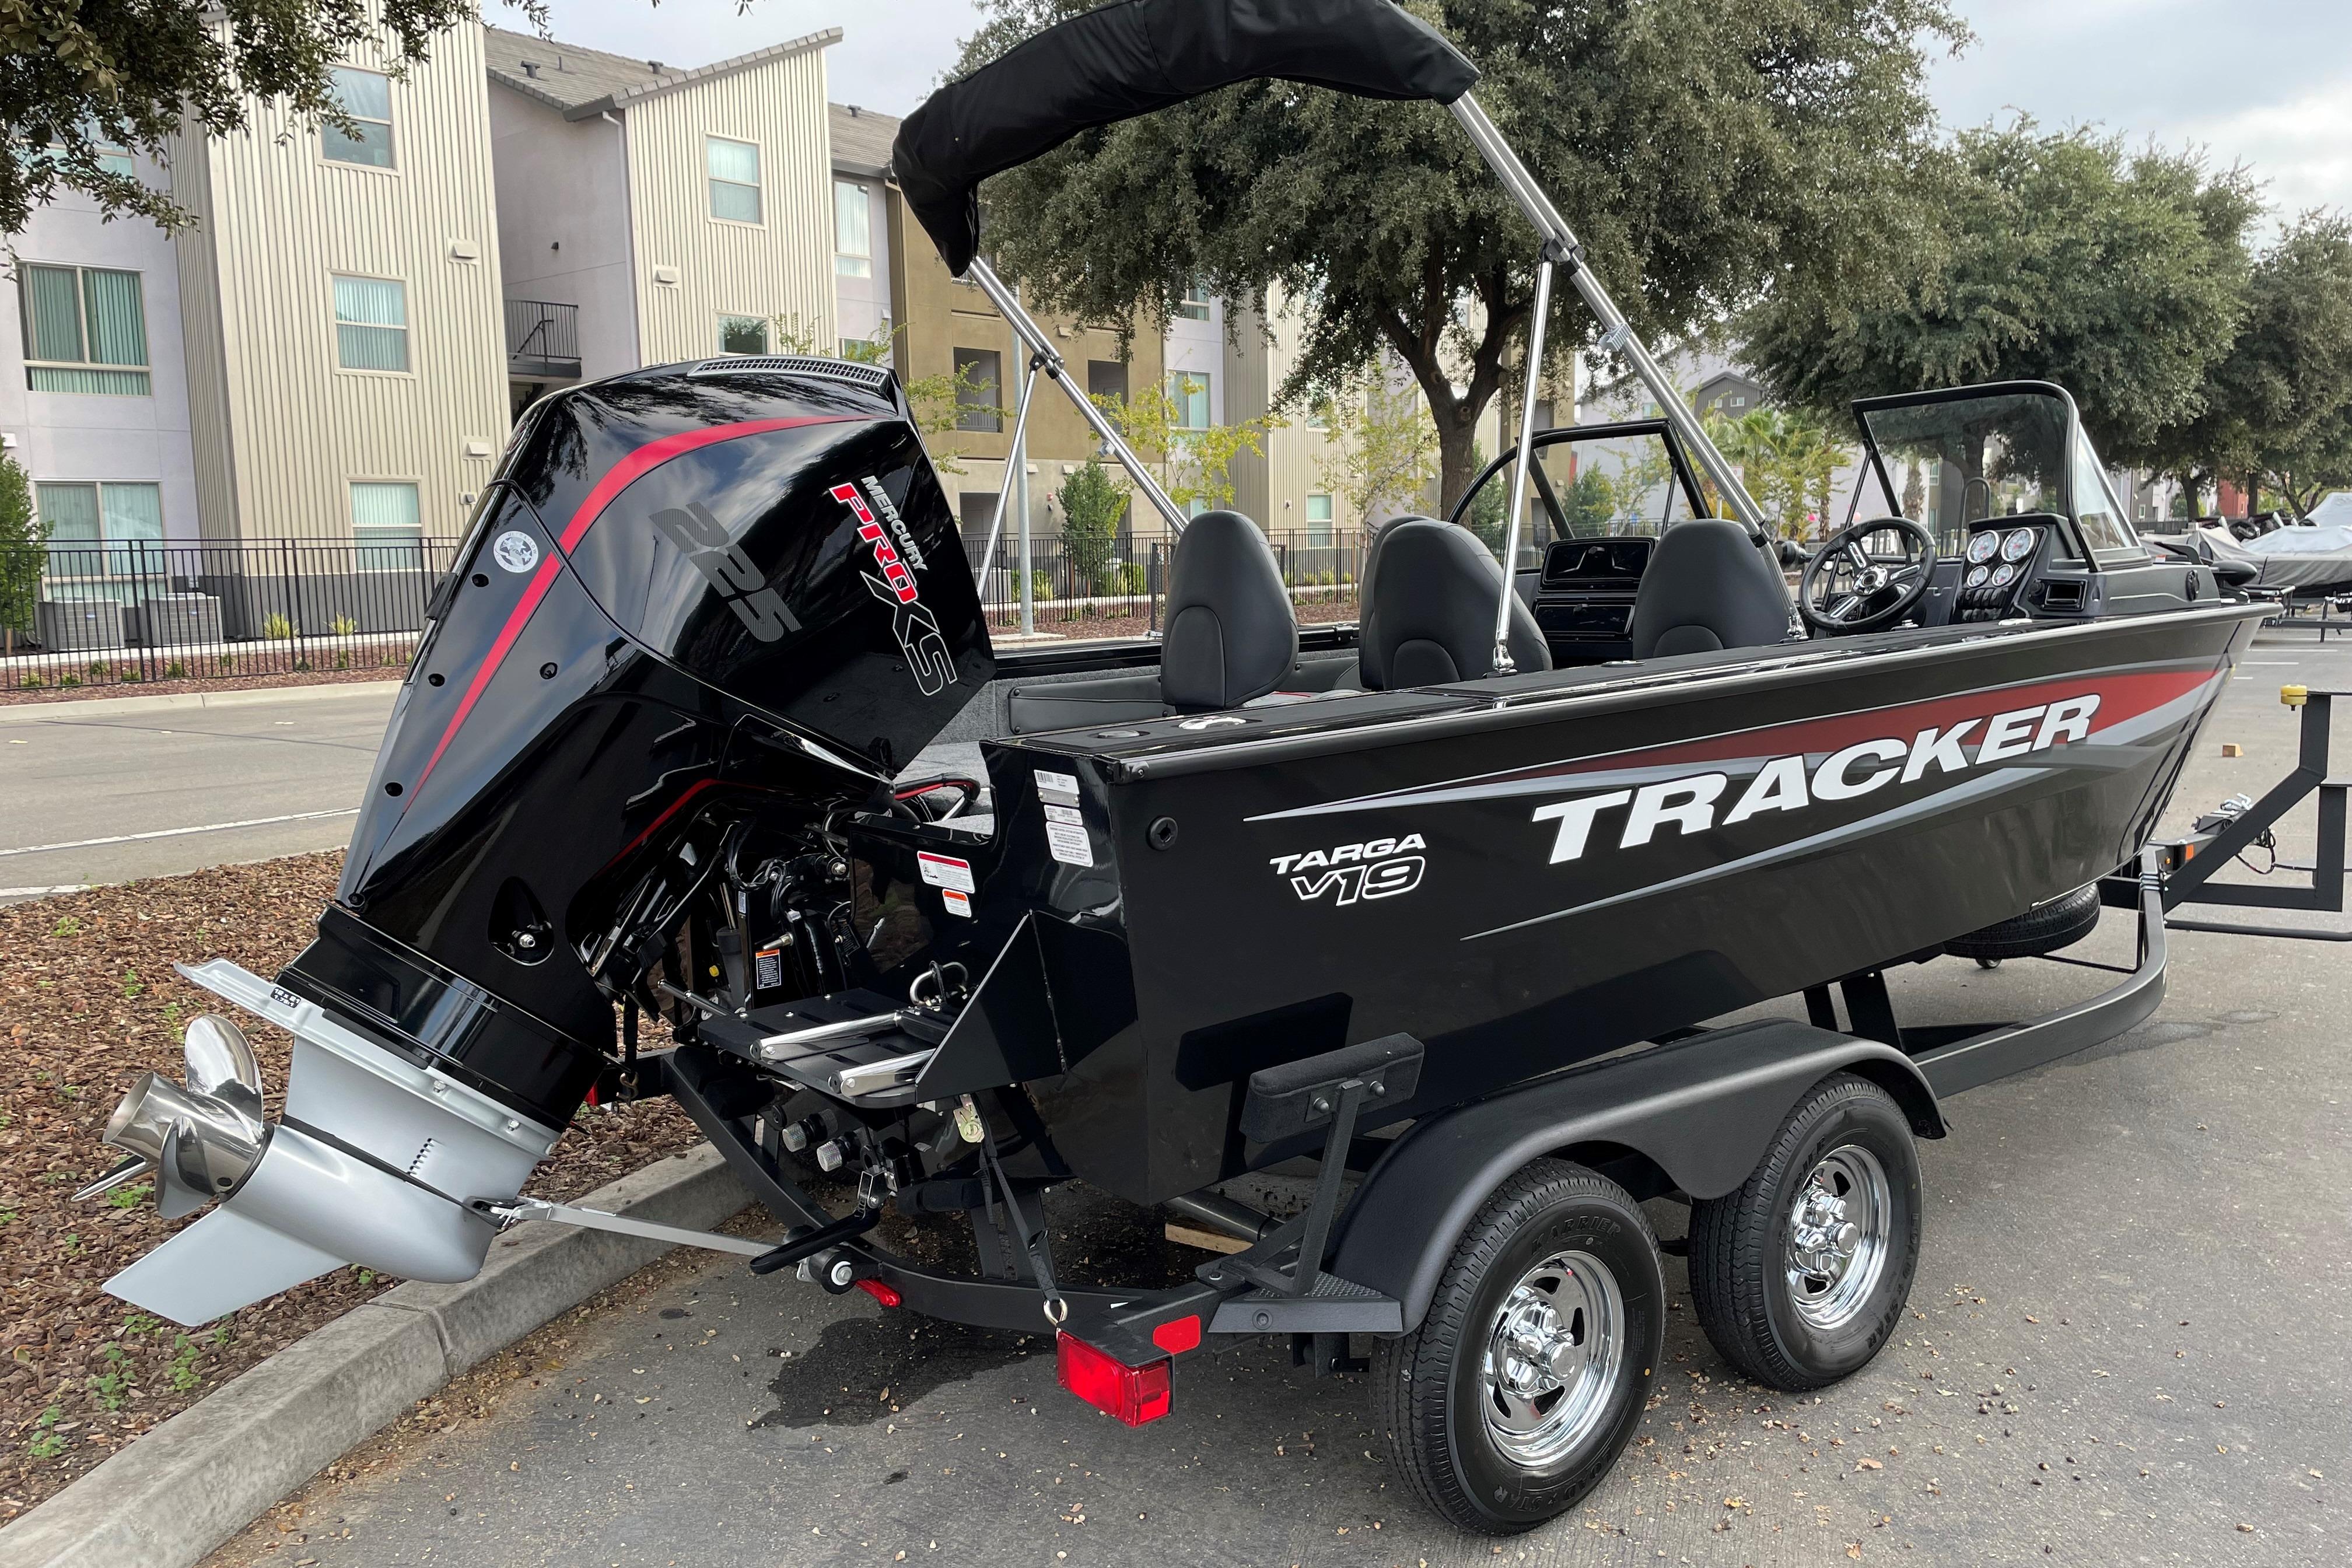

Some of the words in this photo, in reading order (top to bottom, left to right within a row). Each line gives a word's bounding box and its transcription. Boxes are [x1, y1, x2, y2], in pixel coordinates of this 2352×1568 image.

[648, 501, 802, 642] 225
[828, 482, 919, 604] PRO
[861, 475, 928, 572] MERCURY
[860, 558, 958, 696] XS
[1531, 694, 2101, 866] TRACKER
[1269, 833, 1427, 875] TARGA
[1290, 855, 1426, 907] V19
[1531, 1216, 1622, 1255] KARRIER
